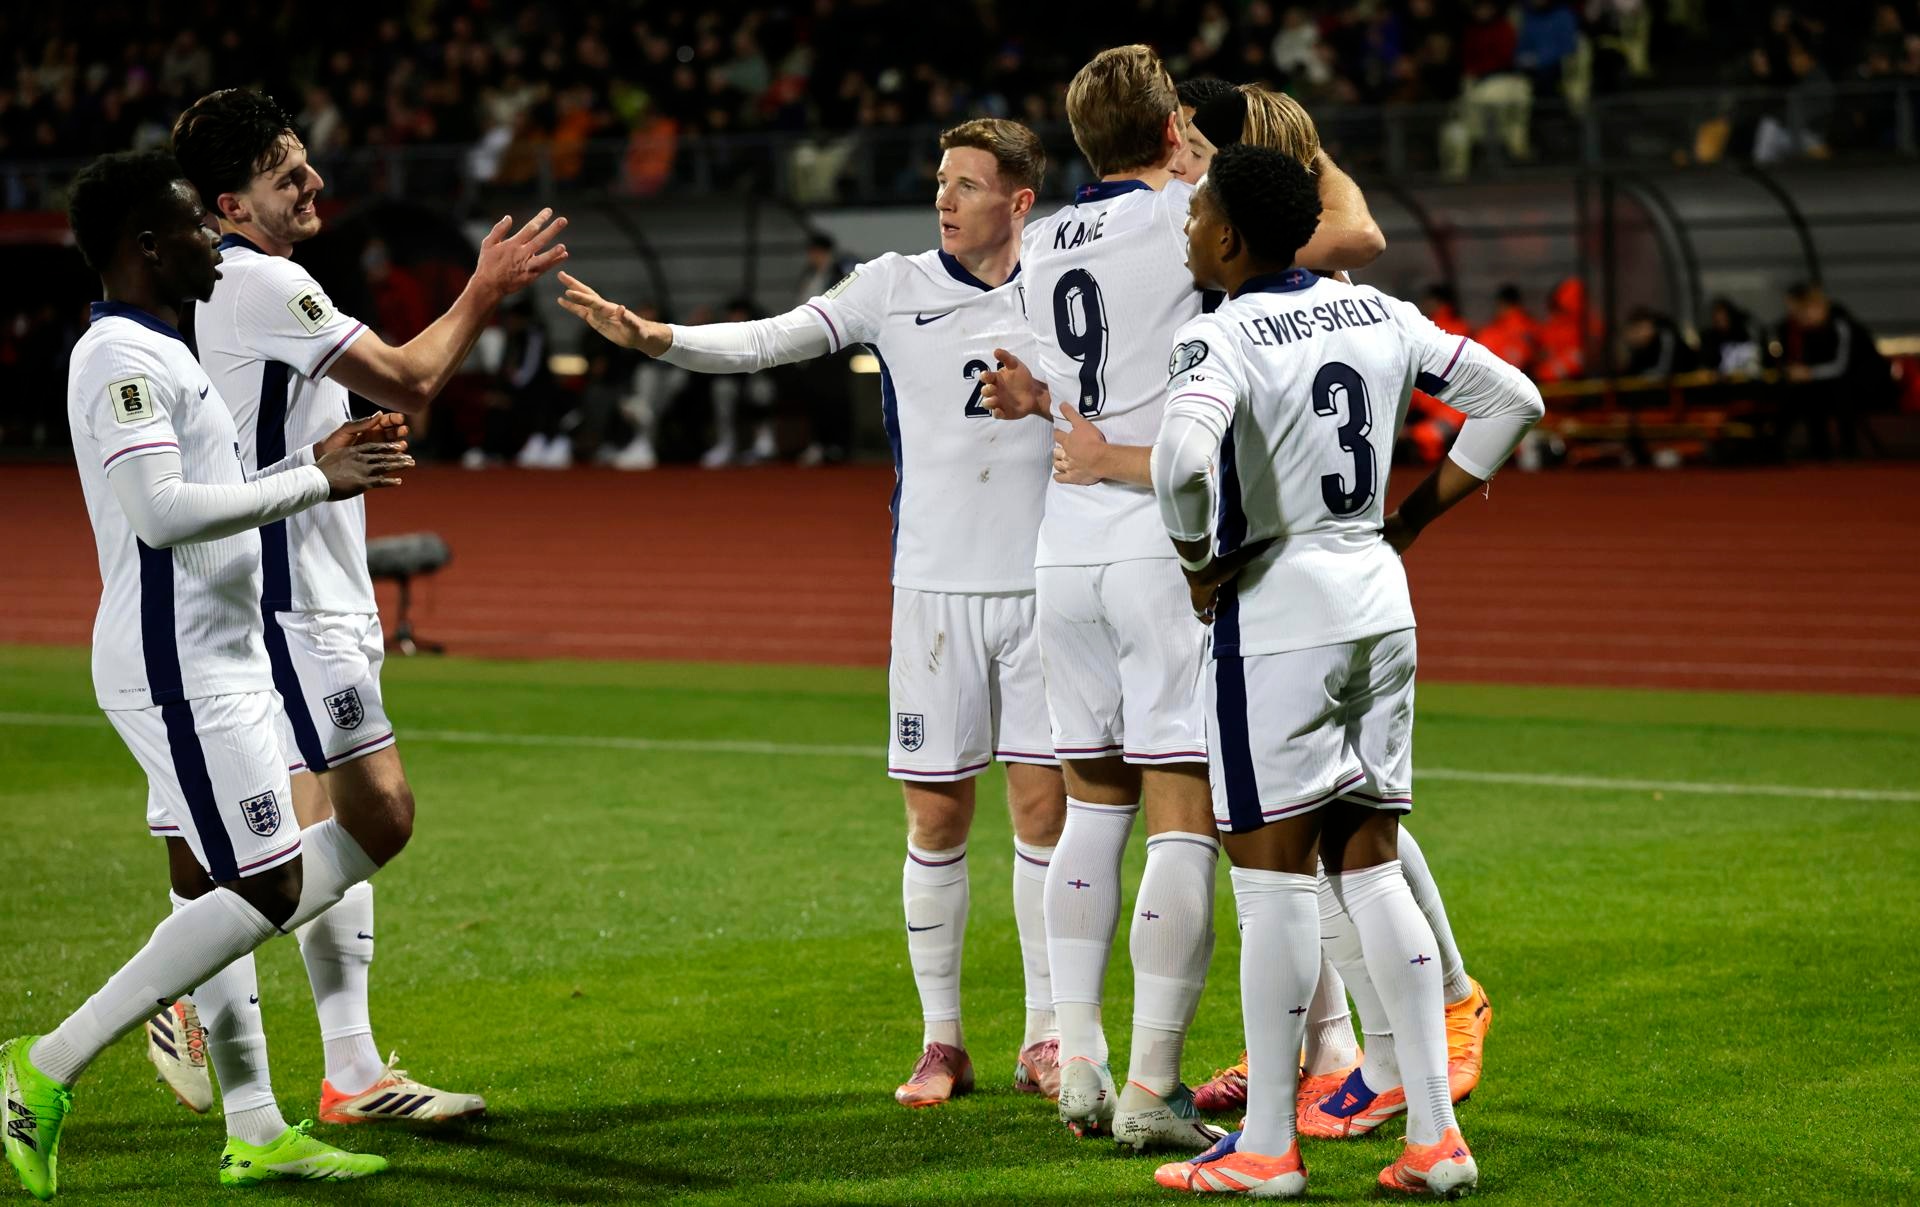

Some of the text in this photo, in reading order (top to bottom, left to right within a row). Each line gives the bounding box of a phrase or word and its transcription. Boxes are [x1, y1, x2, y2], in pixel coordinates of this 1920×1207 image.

[1053, 211, 1108, 250] KANE
[1053, 267, 1109, 418] 9
[1239, 296, 1391, 346] LEWIS-SKELLY
[1312, 361, 1378, 519] 3
